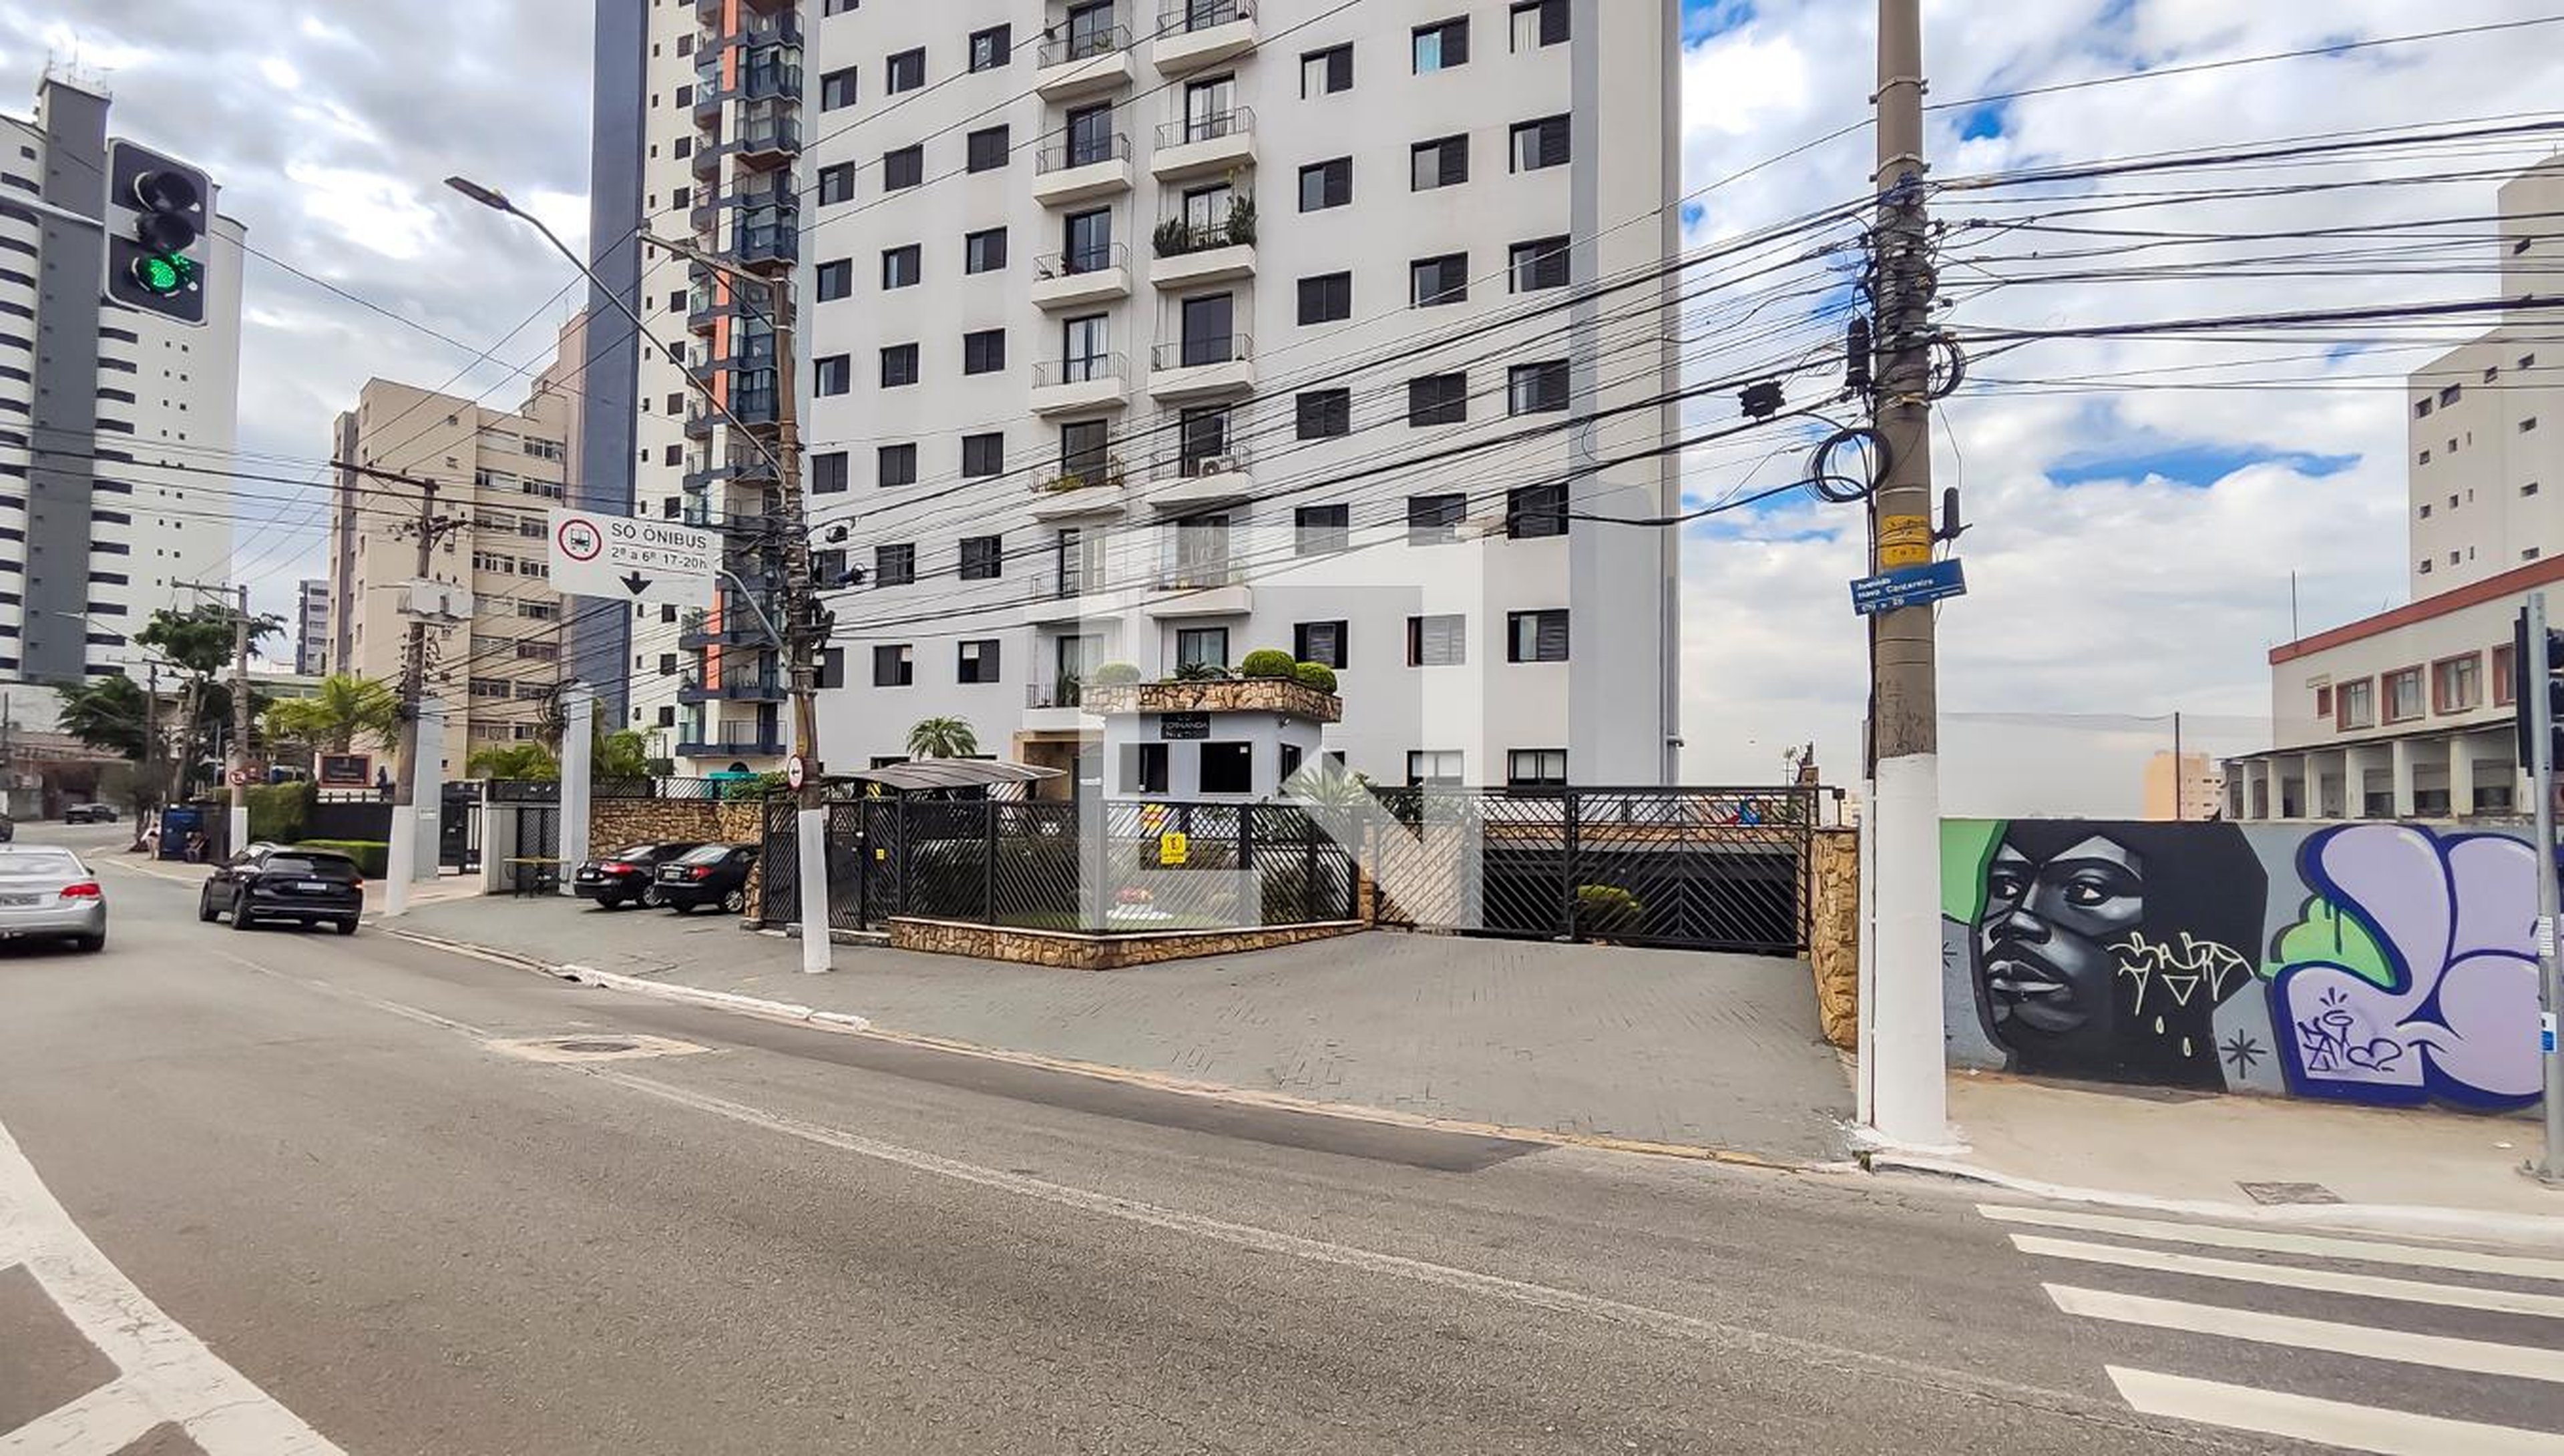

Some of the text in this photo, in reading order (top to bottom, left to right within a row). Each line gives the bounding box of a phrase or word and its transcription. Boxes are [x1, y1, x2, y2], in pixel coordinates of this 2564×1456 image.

[612, 521, 707, 549] SÓ ÔNIBUS
[630, 551, 638, 560] a
[664, 553, 708, 569] 17-20h
